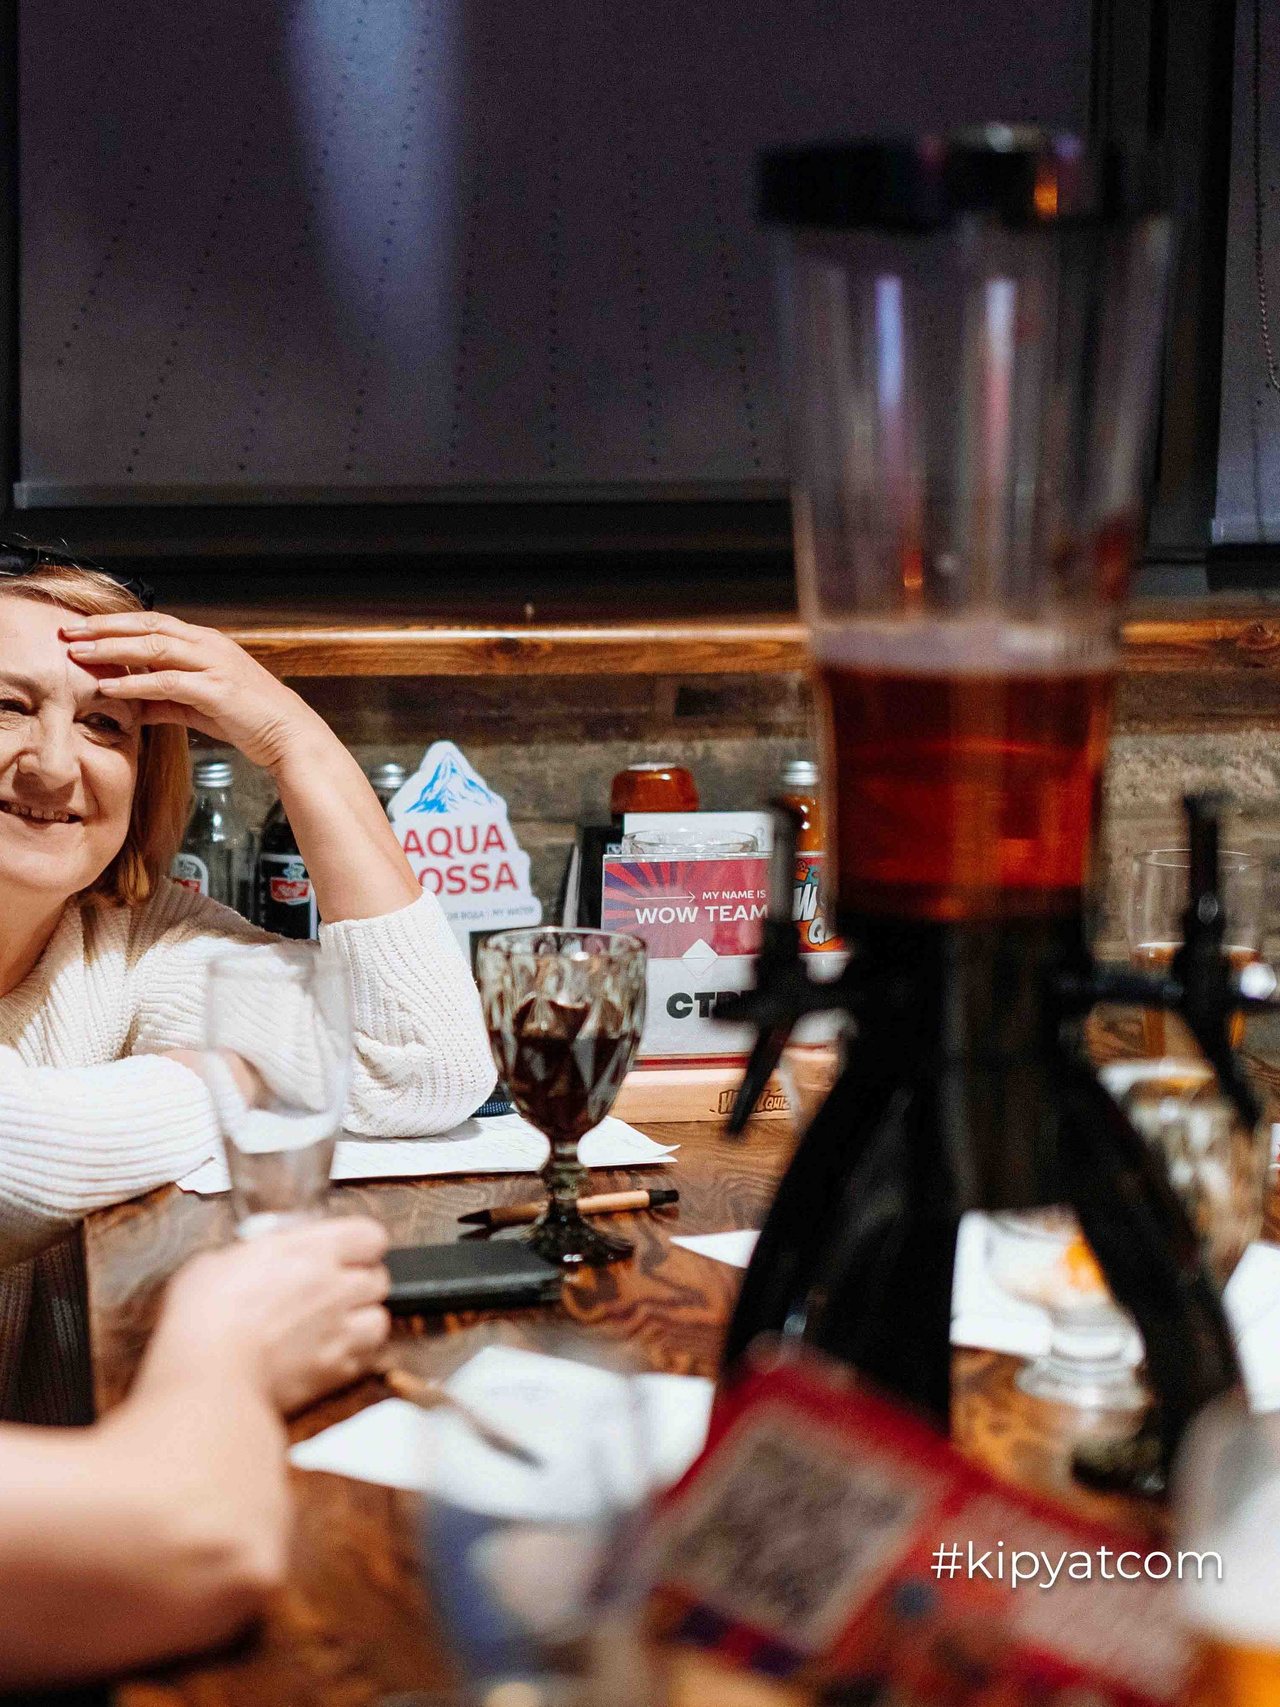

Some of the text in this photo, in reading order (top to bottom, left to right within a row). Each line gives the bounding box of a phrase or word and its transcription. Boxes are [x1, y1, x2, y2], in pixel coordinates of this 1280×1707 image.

[403, 823, 507, 859] AQUA
[418, 861, 519, 896] OSSA
[702, 889, 767, 900] MY NAME IS
[635, 904, 769, 924] WOW TEAM
